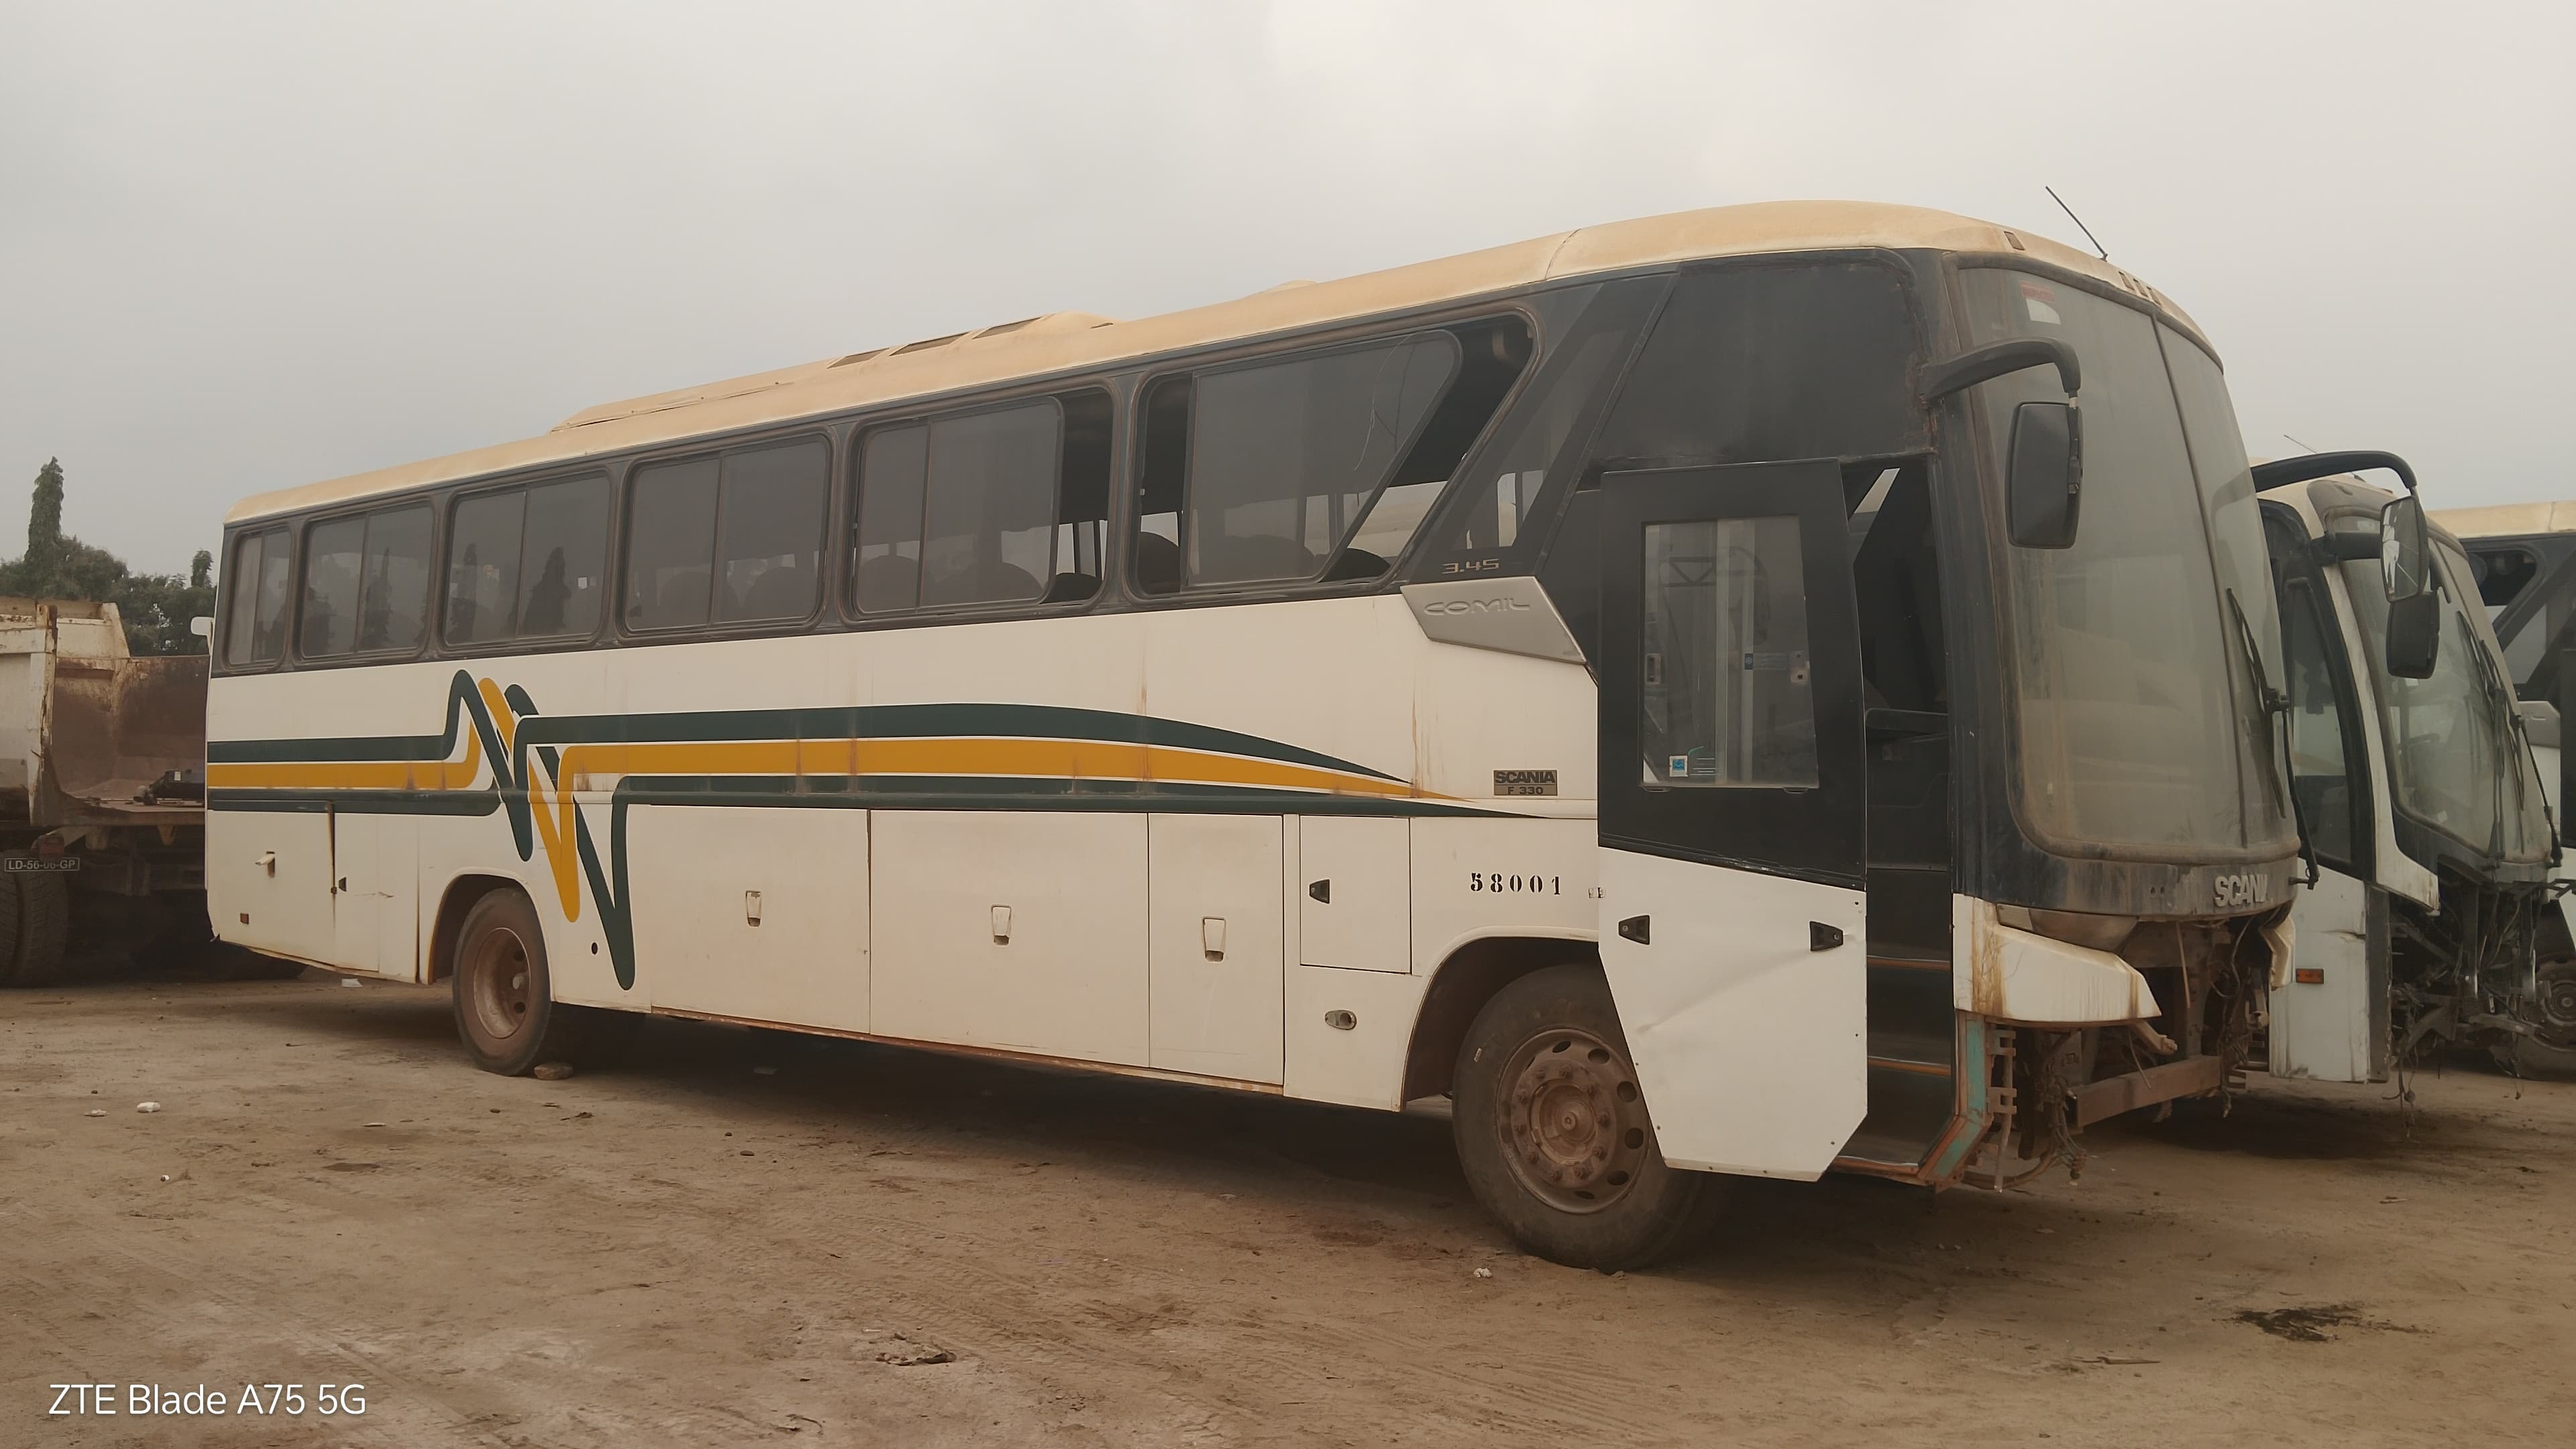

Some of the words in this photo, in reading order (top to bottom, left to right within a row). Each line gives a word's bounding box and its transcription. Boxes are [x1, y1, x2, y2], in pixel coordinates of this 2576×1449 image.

[1441, 558, 1500, 574] 3.45
[1424, 598, 1530, 616] COMIL
[1495, 771, 1556, 784] SCANIA
[1507, 786, 1515, 795] F
[1519, 786, 1544, 795] 330
[1470, 872, 1561, 896] 58001
